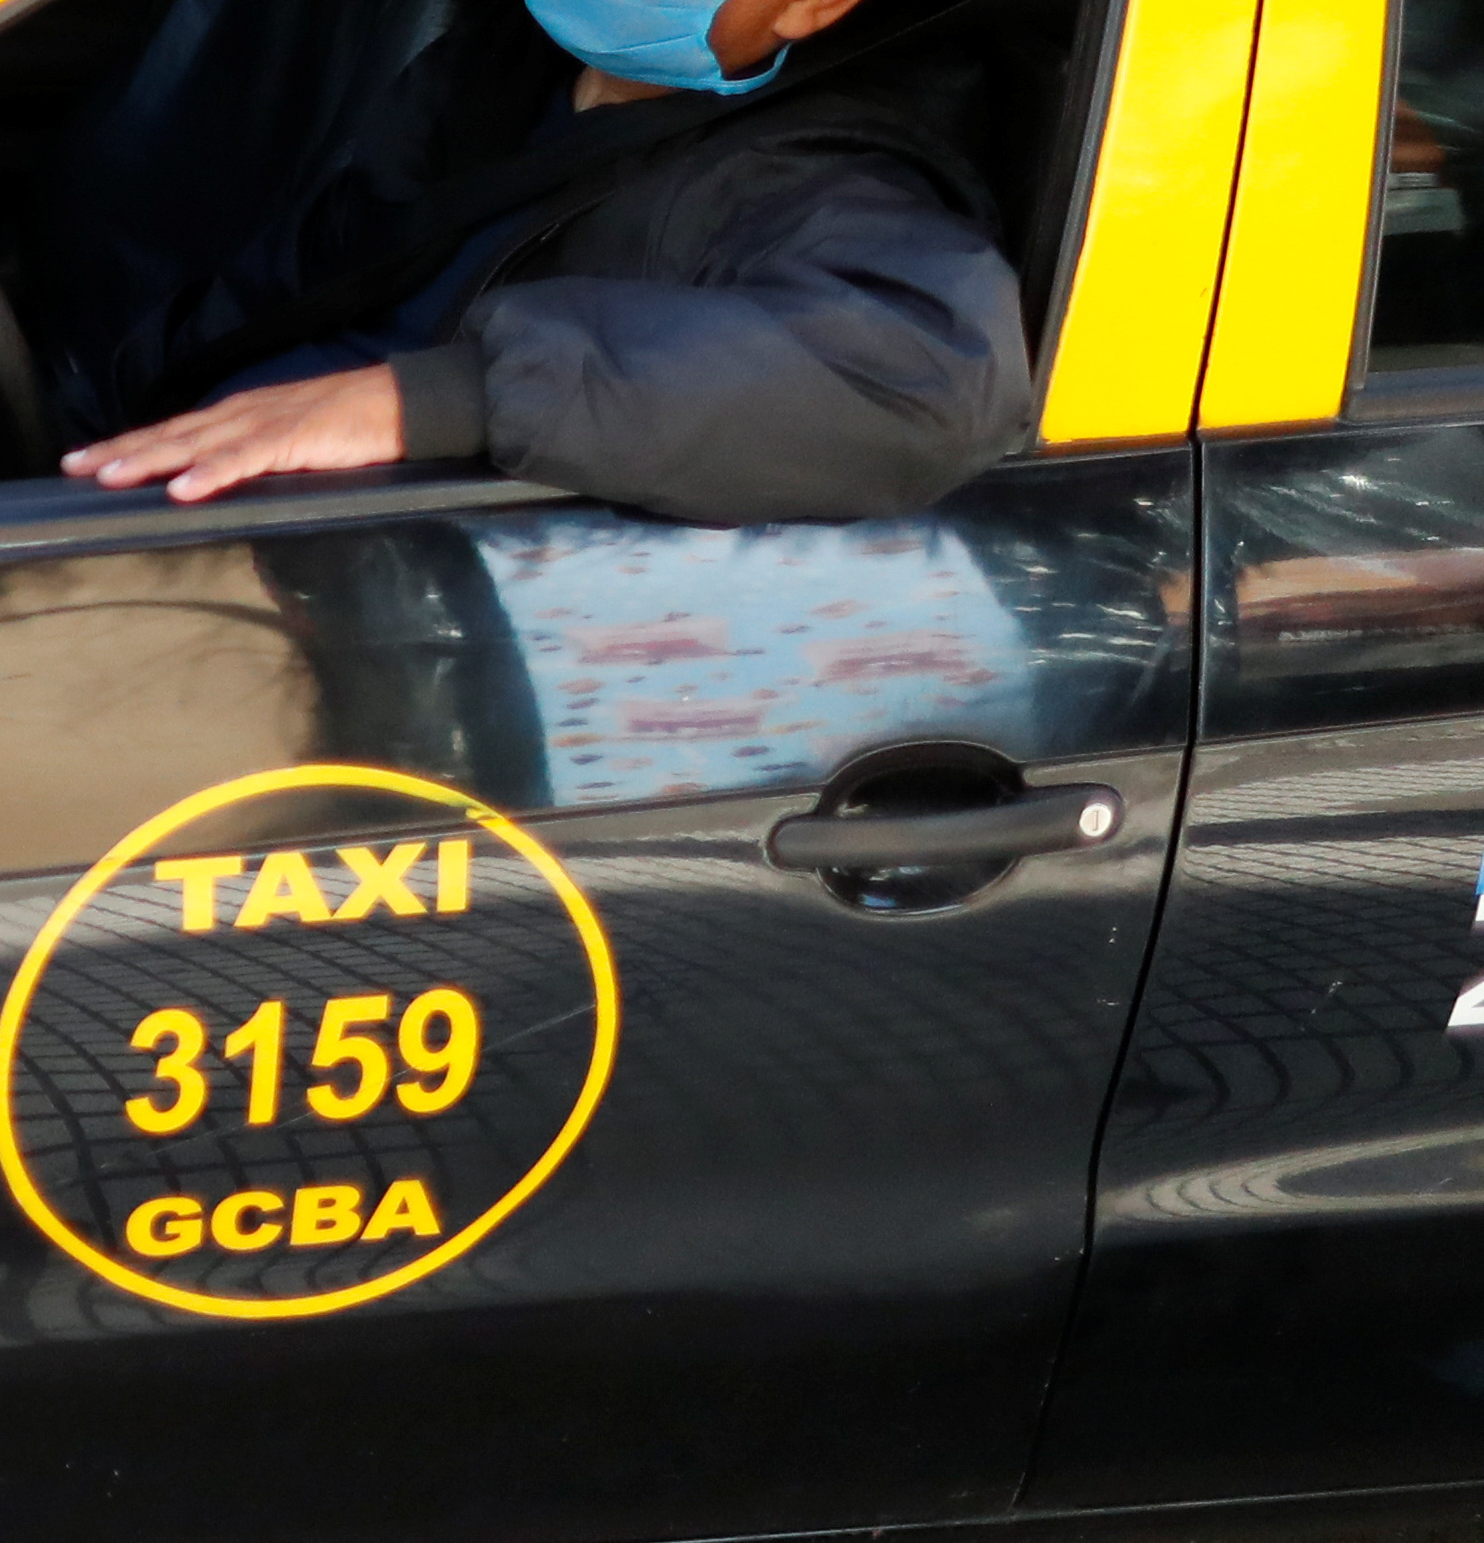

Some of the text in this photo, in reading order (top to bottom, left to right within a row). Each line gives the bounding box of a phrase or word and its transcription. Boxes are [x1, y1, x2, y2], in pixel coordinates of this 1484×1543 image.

[154, 840, 468, 931] TAXI
[125, 988, 483, 1135] 3159
[125, 1179, 441, 1257] GCBA
